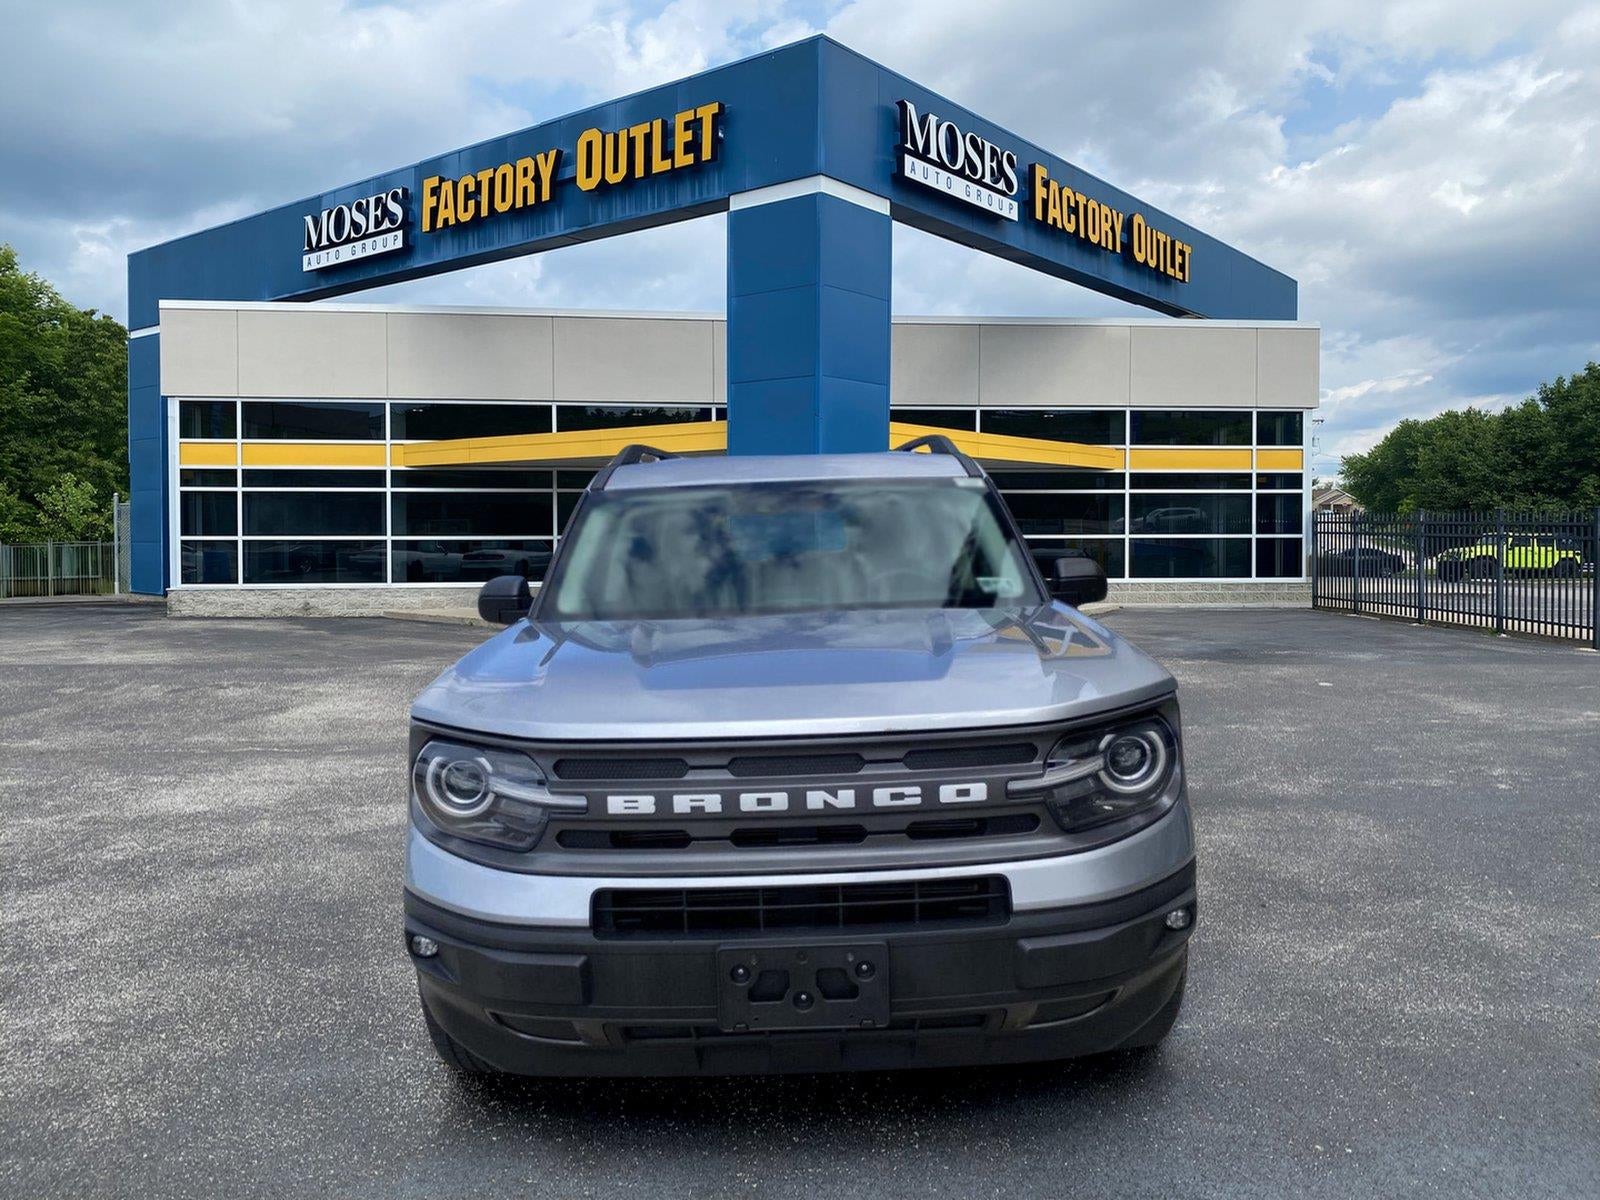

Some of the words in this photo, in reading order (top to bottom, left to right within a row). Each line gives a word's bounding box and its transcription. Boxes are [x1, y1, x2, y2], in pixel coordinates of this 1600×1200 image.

[421, 149, 559, 233] FACTORY
[576, 102, 720, 191] OUTLET
[904, 99, 1019, 196] MOSES
[910, 161, 953, 190] AUTO
[965, 181, 1014, 214] GROUP
[303, 188, 404, 251] MOSES
[306, 247, 341, 267] AUTO
[350, 234, 399, 256] GROUP
[1034, 163, 1124, 253] FACTORY
[1131, 213, 1192, 283] OUTLET
[606, 782, 988, 815] BRONCO
